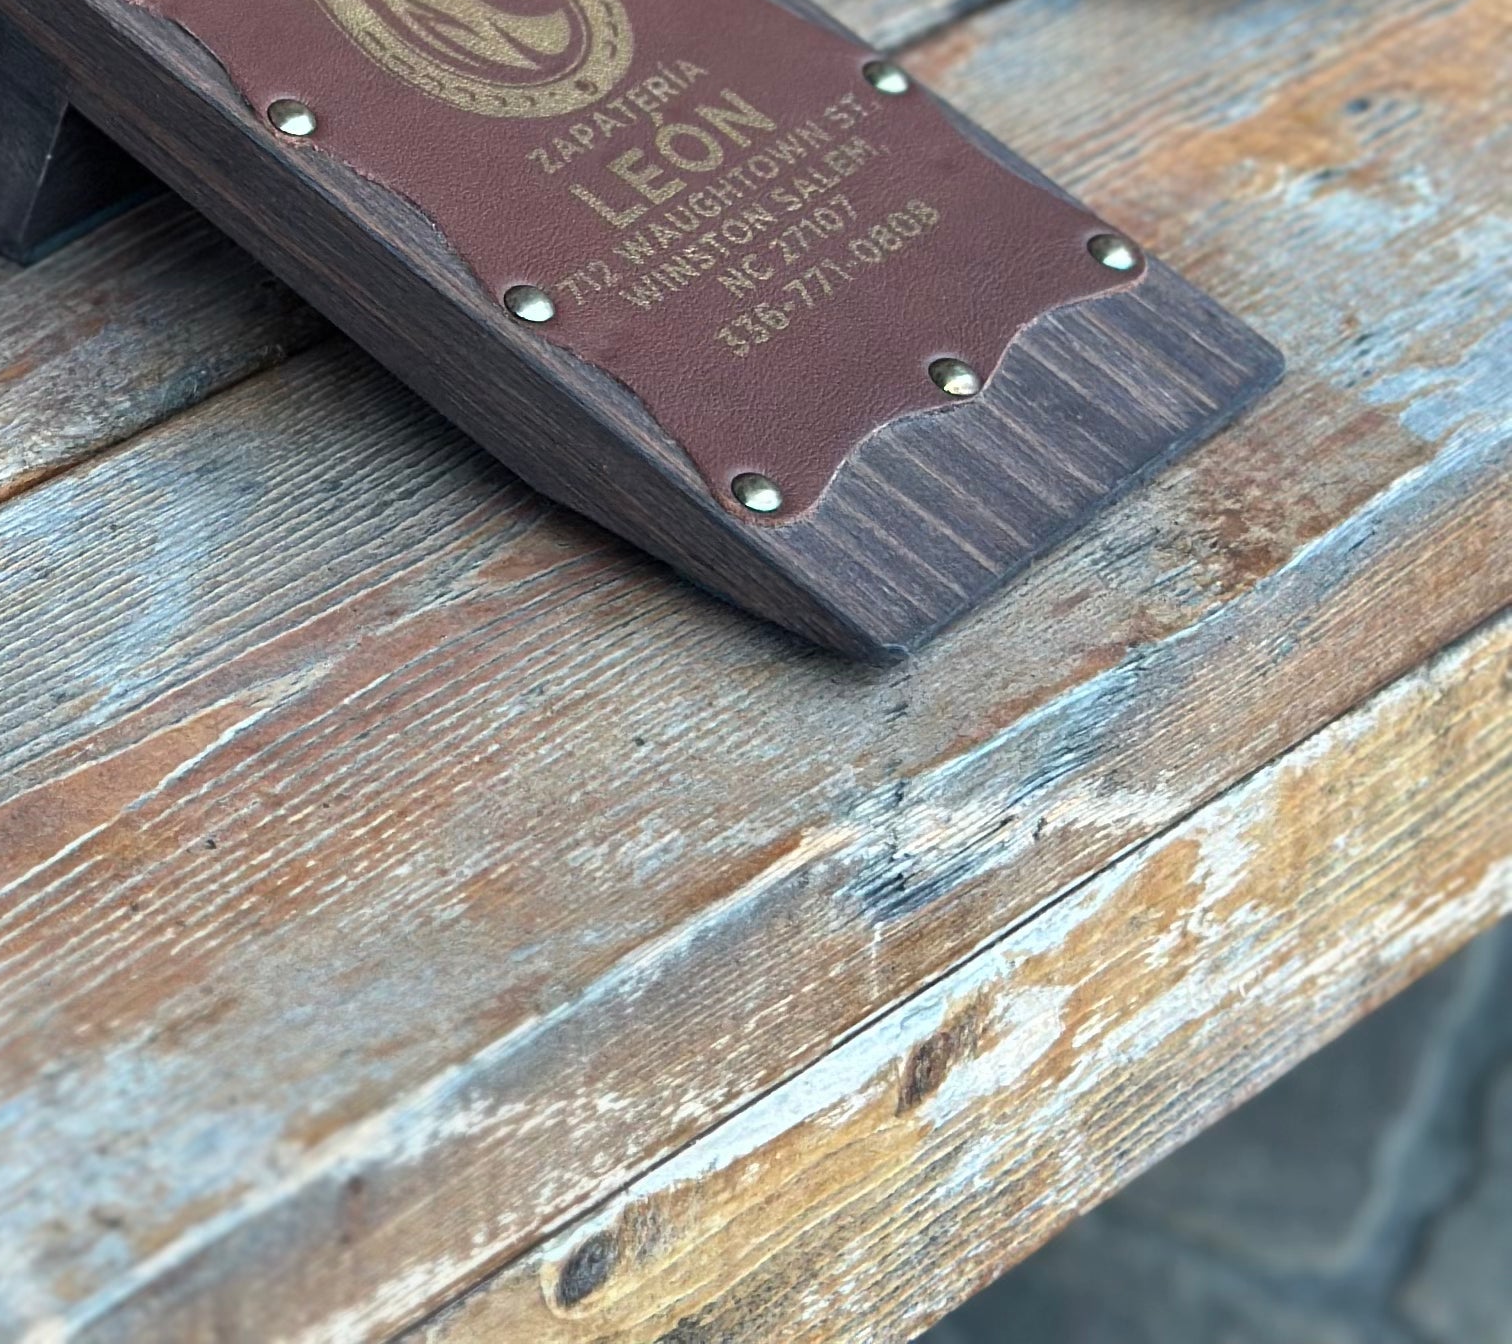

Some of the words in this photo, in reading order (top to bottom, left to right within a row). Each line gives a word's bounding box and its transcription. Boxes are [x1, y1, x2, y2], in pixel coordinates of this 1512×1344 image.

[525, 59, 709, 175] ZAPATERÍA
[568, 87, 777, 229] LEÓN
[554, 260, 619, 306] 712
[612, 119, 832, 265] WAUGHTOWN
[619, 204, 778, 311] WINSTON
[716, 254, 775, 298] NC
[769, 193, 857, 265] 27107
[714, 199, 938, 357] 336-771-0808
